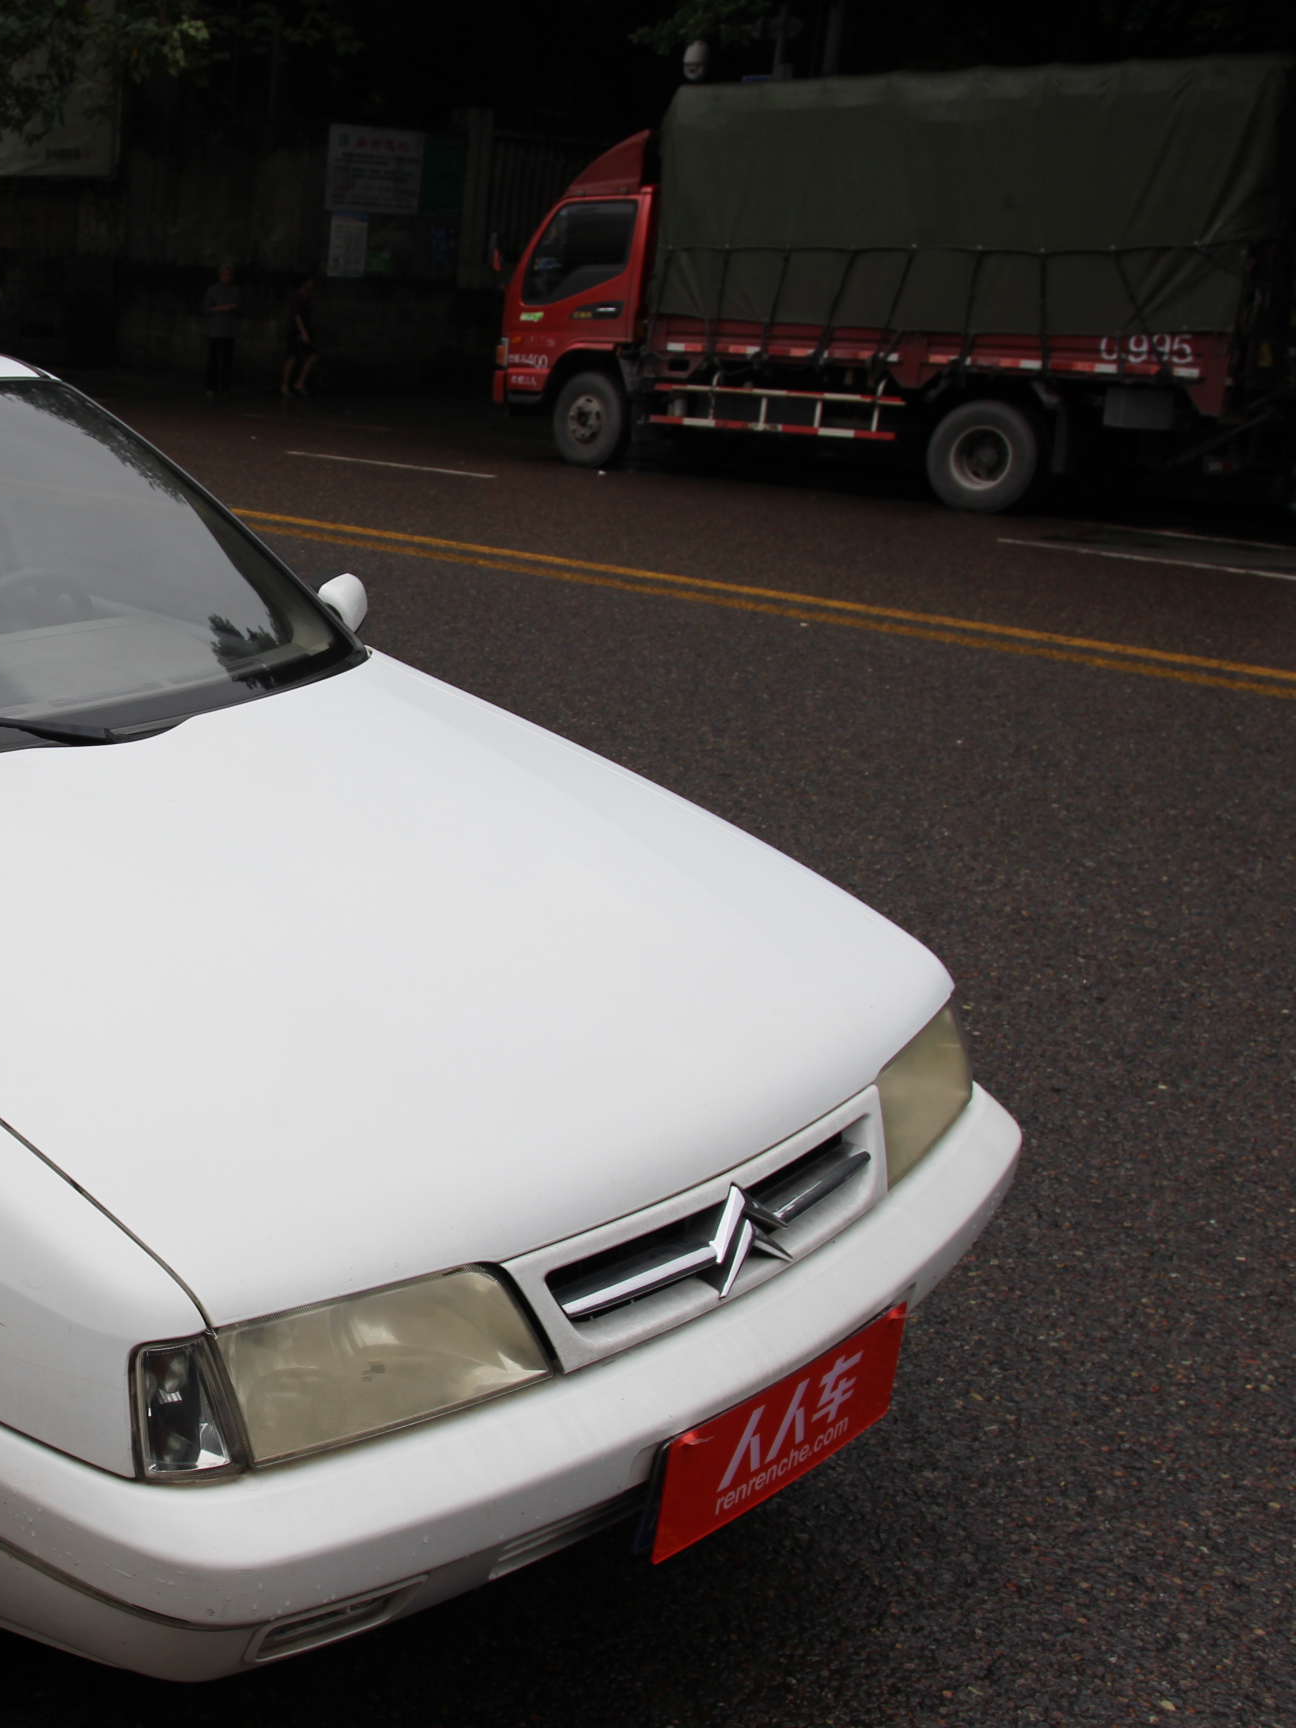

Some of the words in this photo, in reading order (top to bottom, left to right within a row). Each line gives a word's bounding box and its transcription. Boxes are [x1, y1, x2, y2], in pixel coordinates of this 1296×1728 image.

[714, 1416, 848, 1516] renrenche.com
[716, 1349, 864, 1493] 人人车
